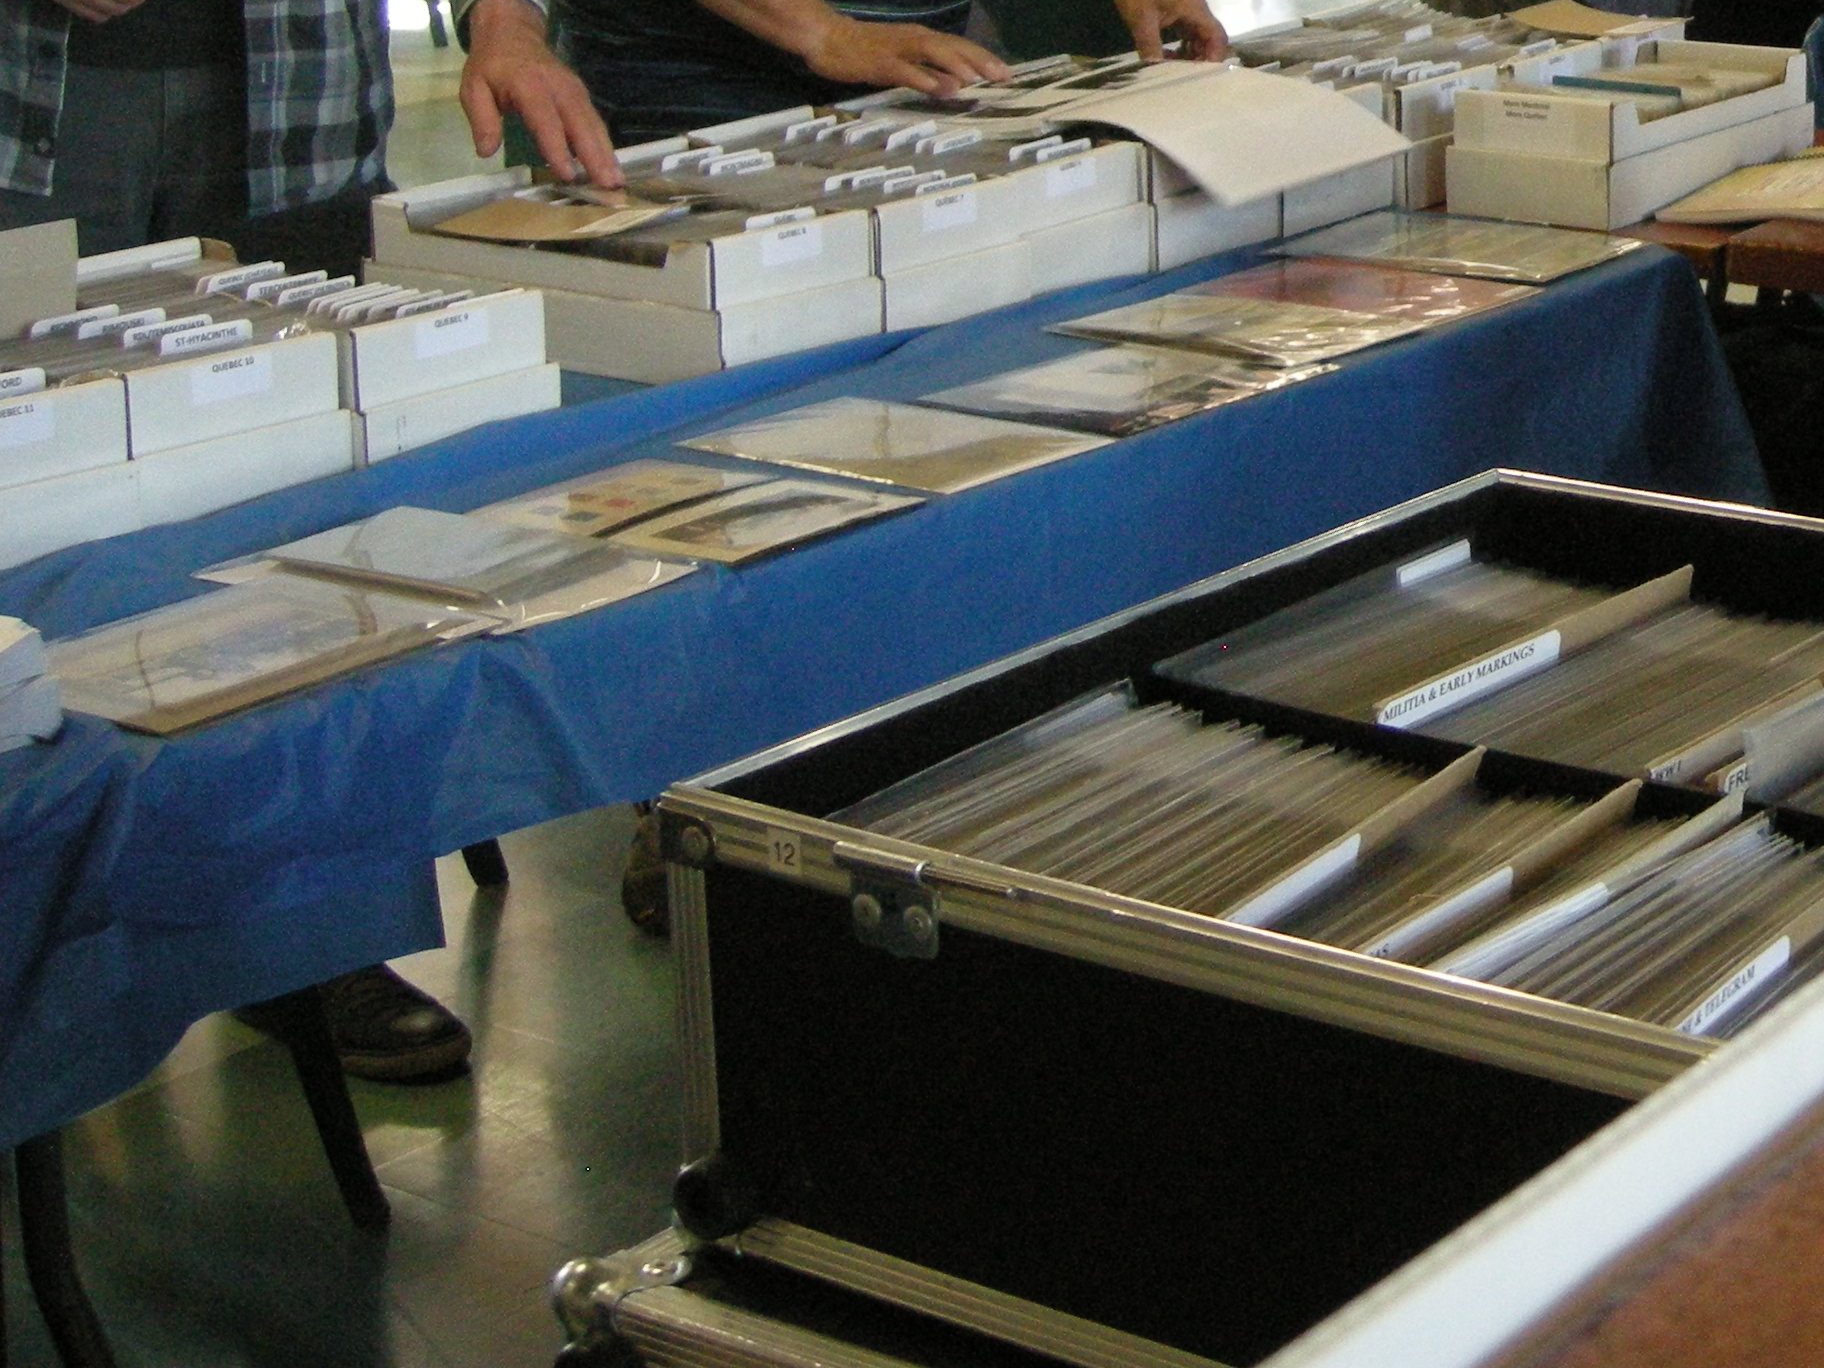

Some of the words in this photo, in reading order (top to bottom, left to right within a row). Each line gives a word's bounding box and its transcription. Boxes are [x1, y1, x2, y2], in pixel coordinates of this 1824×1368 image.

[175, 327, 239, 348] ST-HYACINTHE
[1382, 693, 1427, 723] MILITIA
[1428, 688, 1437, 701] &
[1439, 670, 1475, 697] EARLY
[1475, 643, 1536, 680] MARKINGS
[773, 840, 796, 867] 12
[1705, 965, 1756, 1017] TELEGRAM
